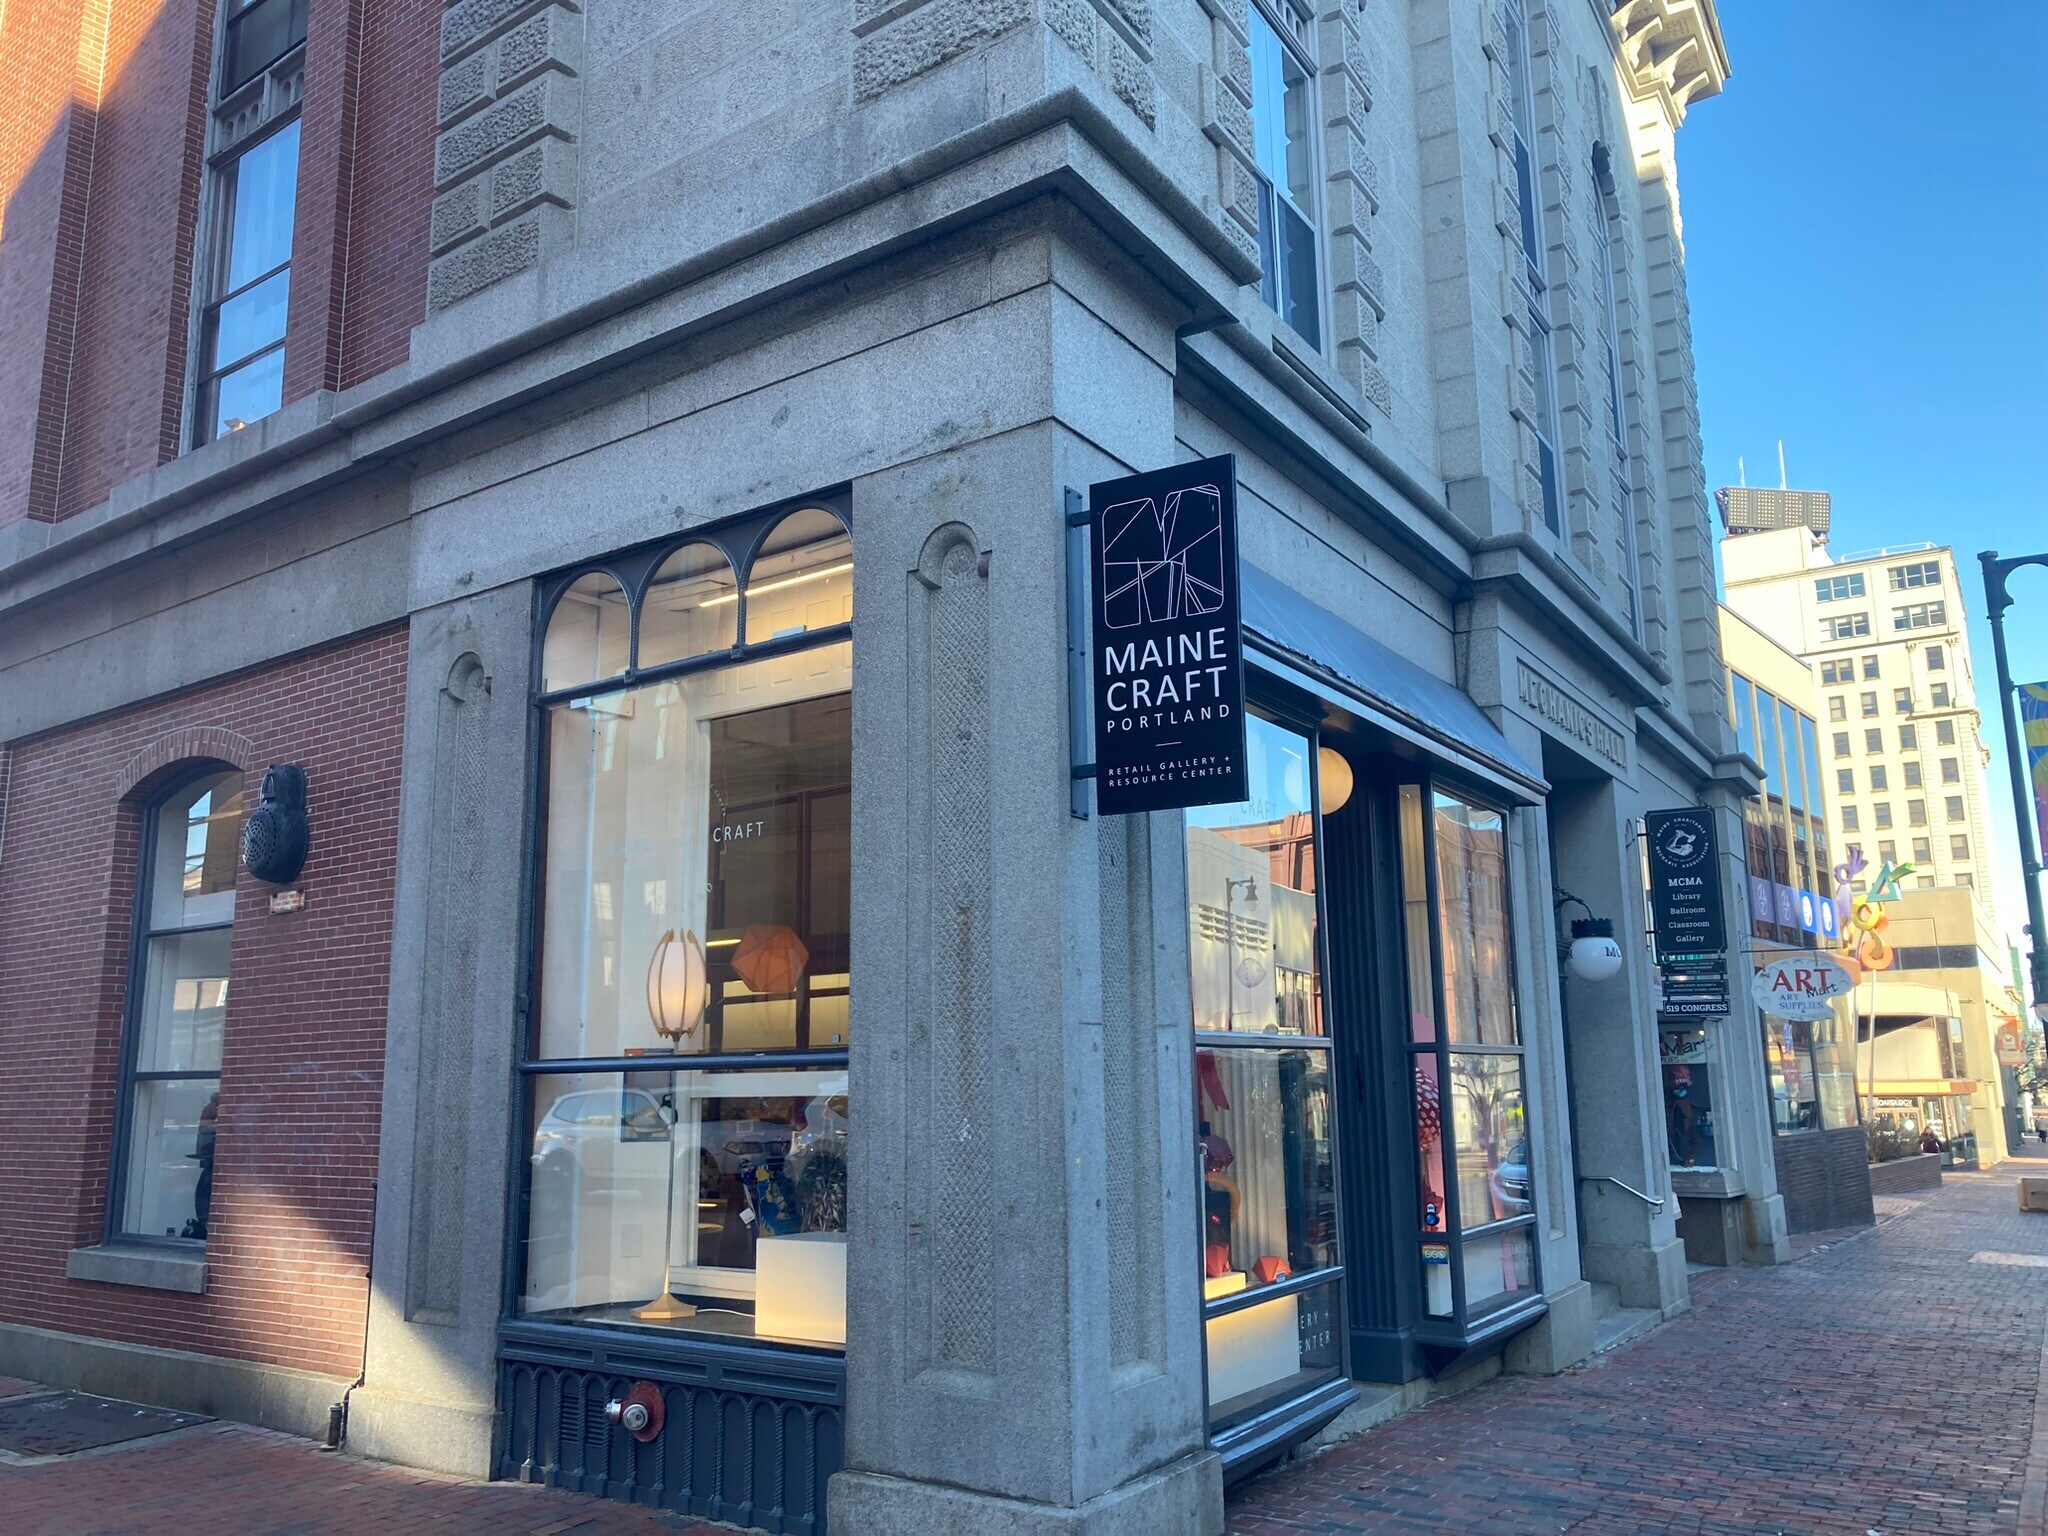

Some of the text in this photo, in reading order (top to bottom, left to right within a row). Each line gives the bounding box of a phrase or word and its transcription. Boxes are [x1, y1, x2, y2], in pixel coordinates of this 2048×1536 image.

[1105, 627, 1227, 676] MAINE
[1106, 666, 1227, 712] CRAFT
[1107, 704, 1230, 733] PORTLAND
[1108, 764, 1152, 776] RETAIL
[1159, 756, 1216, 770] GALLERY
[1109, 766, 1232, 787] RESOURCE CENTER
[713, 821, 764, 843] CRAFT
[1656, 817, 1707, 838] MAINE CHARITABLE
[1655, 841, 1709, 868] MECHANIC ASSOCIATION
[1668, 877, 1703, 887] MCMA
[1672, 893, 1701, 901] Library
[1670, 907, 1706, 915] Ballroom
[1668, 921, 1710, 929] Classroom
[1675, 934, 1705, 943] Gallery
[1772, 969, 1832, 992] ART
[1806, 982, 1839, 999] Mart
[1681, 1003, 1728, 1012] CONGRESS
[1779, 1001, 1824, 1010] SUPPLIES
[1300, 1310, 1319, 1330] ERY
[1299, 1330, 1331, 1355] ENTER
